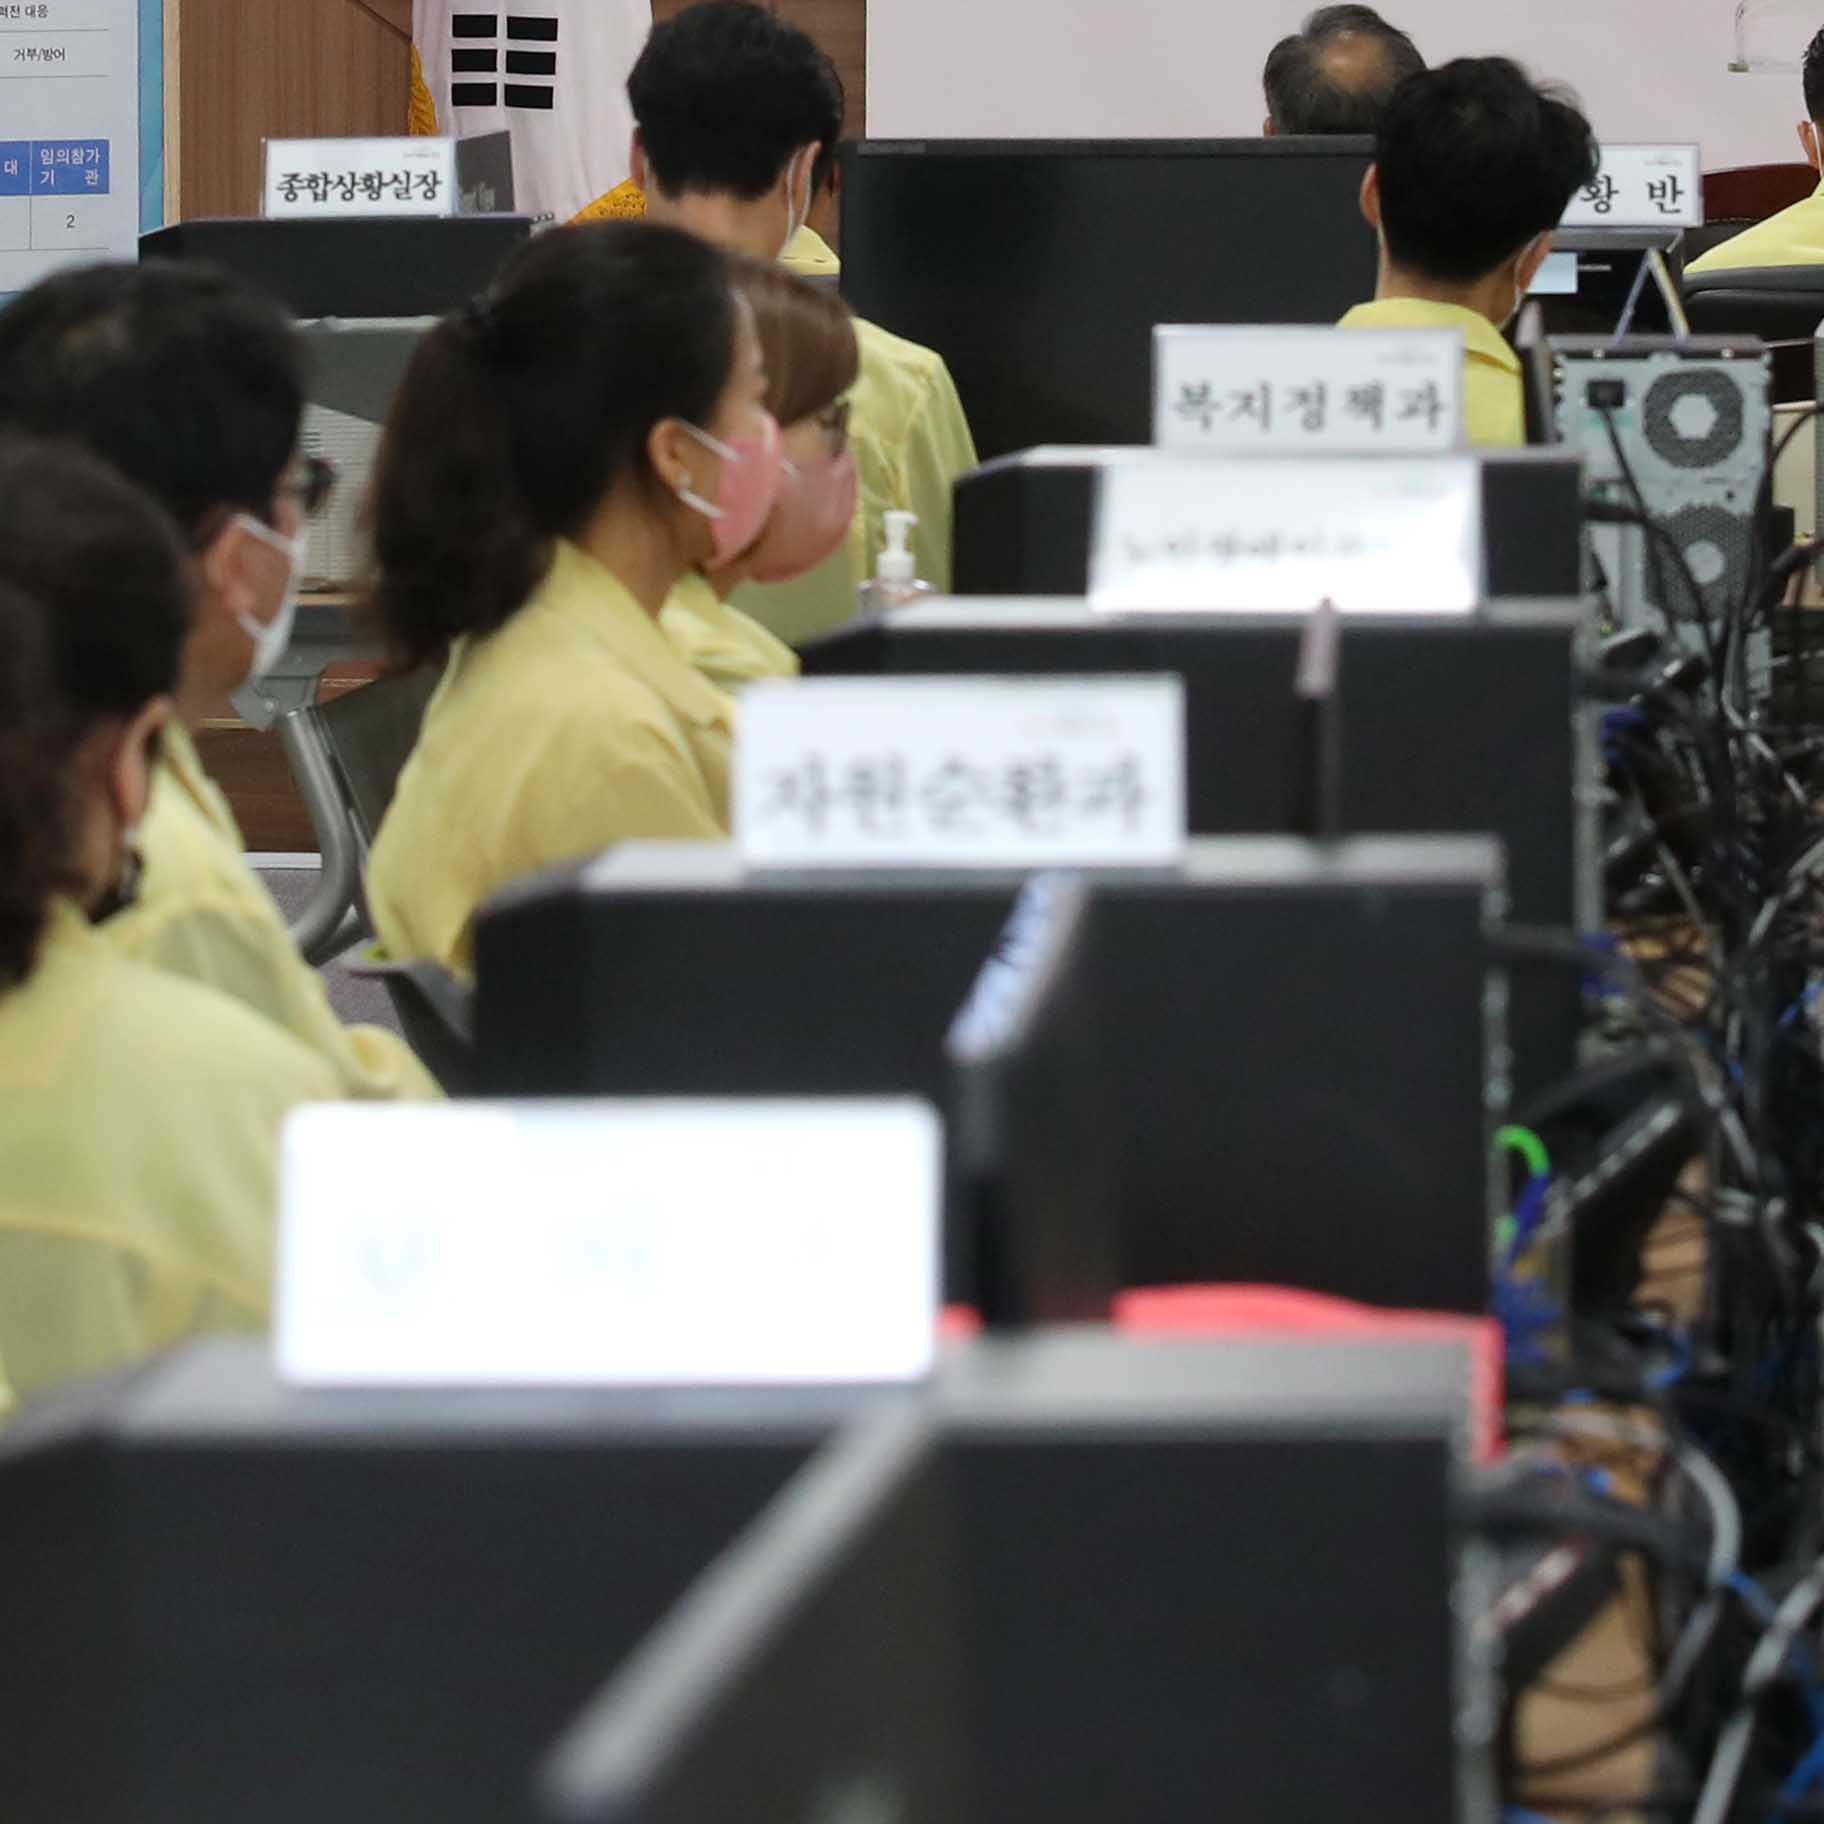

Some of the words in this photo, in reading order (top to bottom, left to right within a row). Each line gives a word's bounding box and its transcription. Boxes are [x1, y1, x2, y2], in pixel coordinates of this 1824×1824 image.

[40, 147, 101, 166] 임의참가
[275, 169, 443, 204] 종합상황실장
[65, 215, 75, 229] 2
[1174, 379, 1447, 433] 복지정책과
